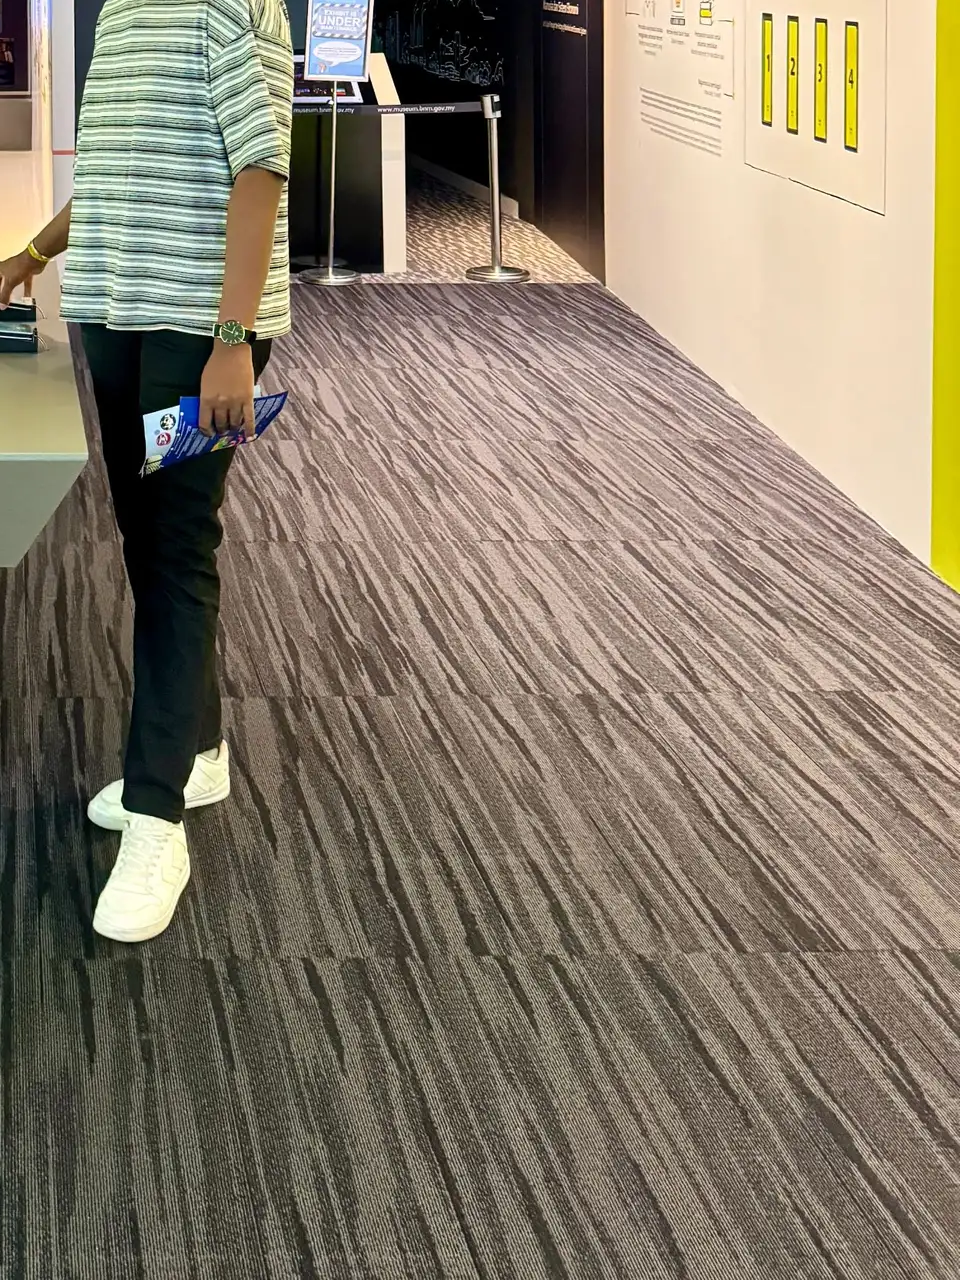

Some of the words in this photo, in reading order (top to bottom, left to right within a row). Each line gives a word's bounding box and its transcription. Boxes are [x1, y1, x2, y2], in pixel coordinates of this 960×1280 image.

[319, 15, 361, 27] UNDER
[767, 54, 770, 72] 1
[790, 57, 795, 76] 2
[818, 63, 823, 82] 3
[849, 69, 854, 89] 4
[293, 106, 355, 114] museum.bnmov.my
[377, 104, 456, 113] www.museum.bnm.gov.my
